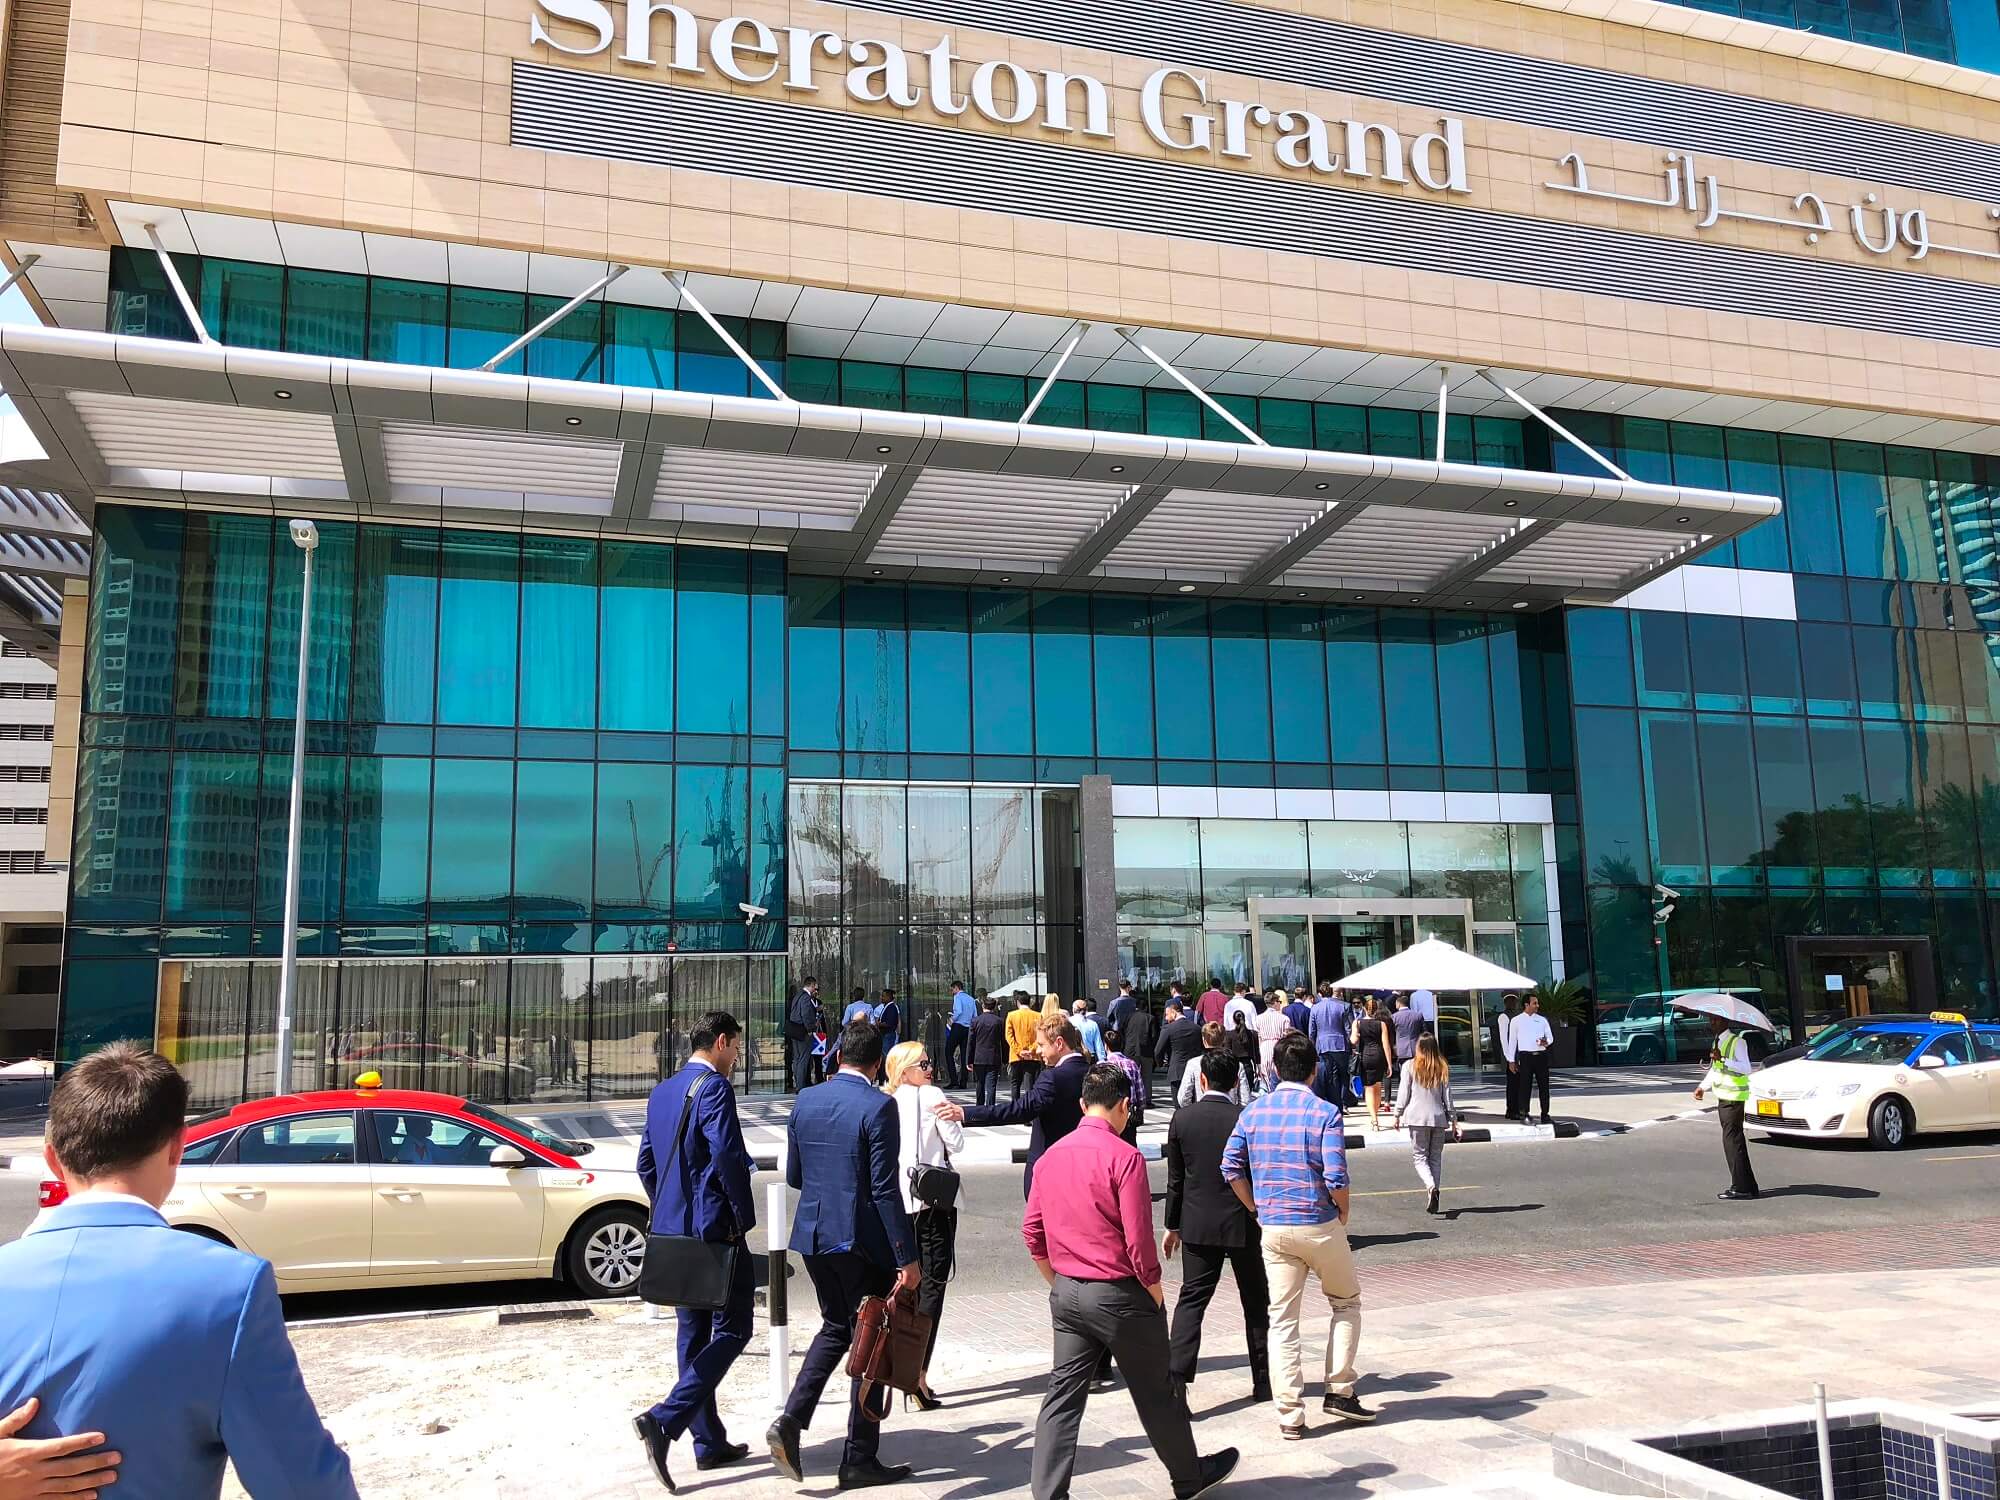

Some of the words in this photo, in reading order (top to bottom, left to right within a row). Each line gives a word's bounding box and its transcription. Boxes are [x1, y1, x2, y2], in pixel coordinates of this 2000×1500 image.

[530, 0, 1116, 138] Sheraton
[1139, 67, 1473, 194] Grand
[1543, 150, 1833, 246] جراند
